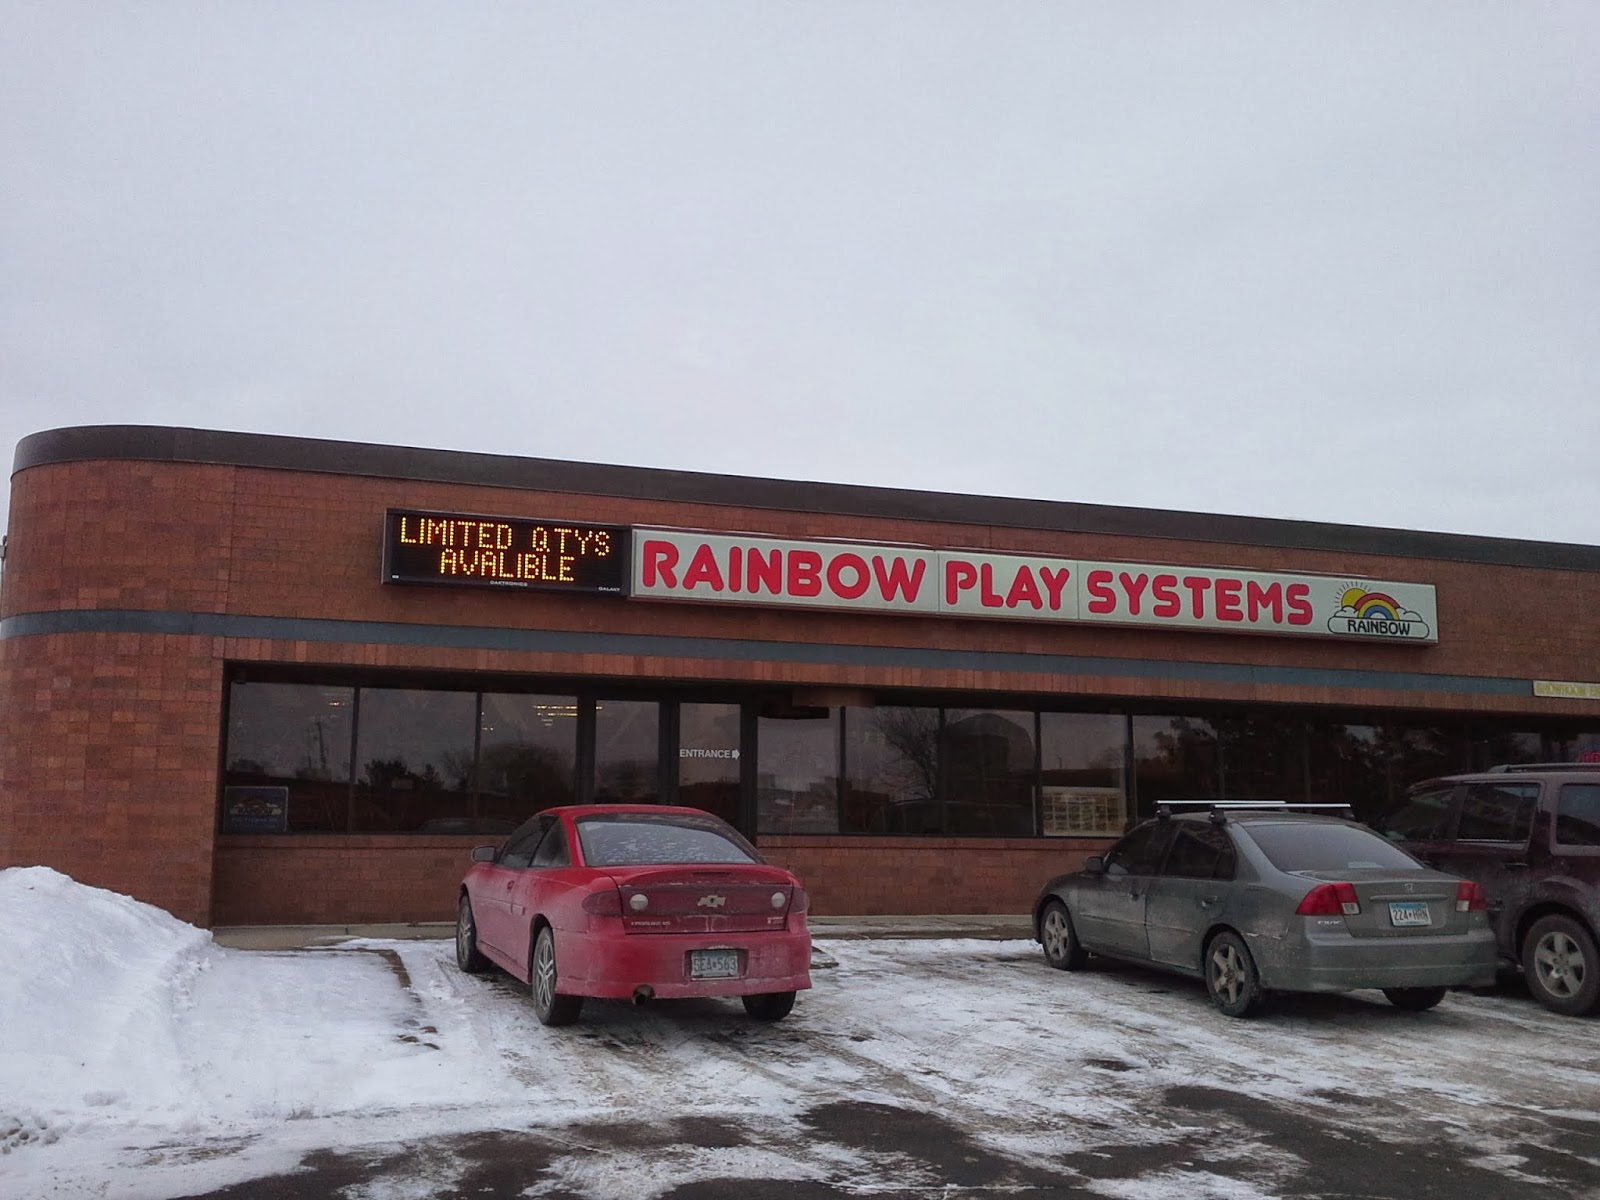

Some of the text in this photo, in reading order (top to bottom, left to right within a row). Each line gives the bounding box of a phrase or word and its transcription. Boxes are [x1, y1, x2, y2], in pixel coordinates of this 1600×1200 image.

[400, 516, 610, 557] LIMITED QTYS
[440, 548, 575, 582] AVALIBLE
[642, 540, 1314, 626] RAINBOW PLAY SYSTEMS
[1347, 619, 1411, 636] RAINBOW
[679, 748, 731, 759] ENTRANCE
